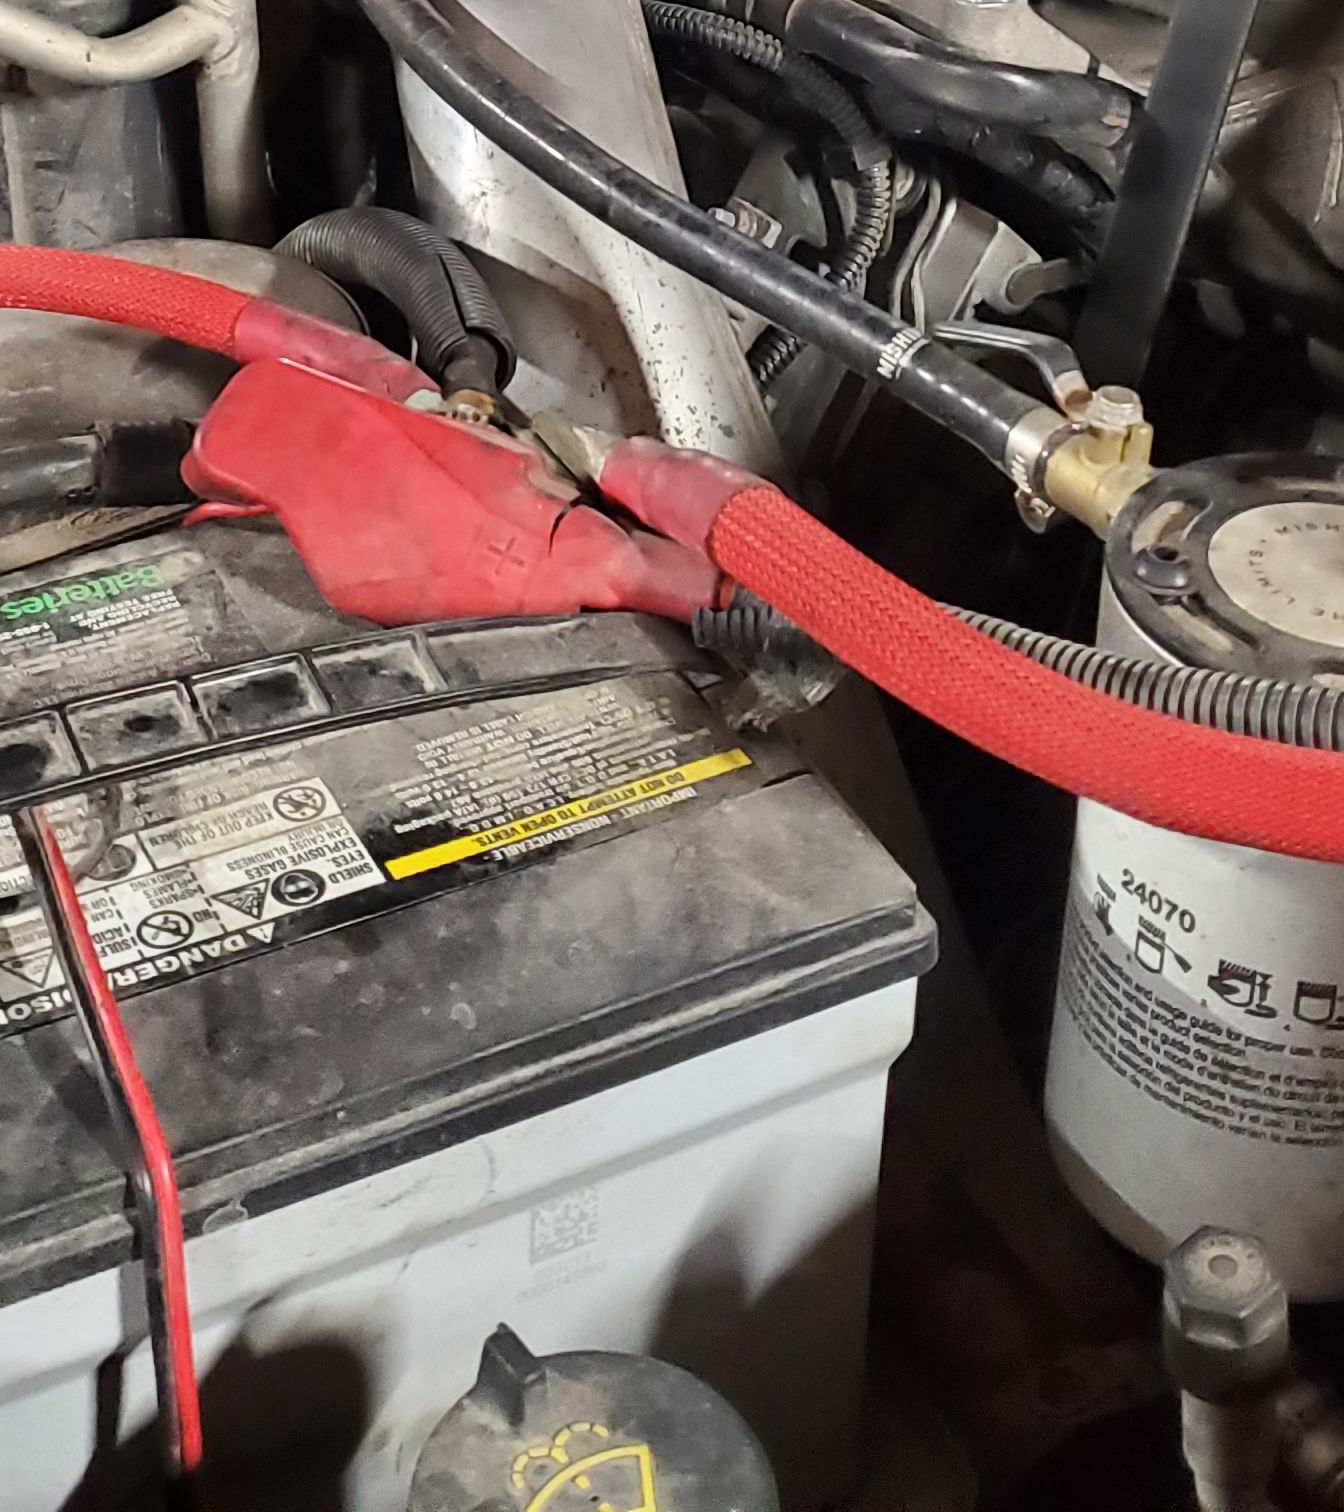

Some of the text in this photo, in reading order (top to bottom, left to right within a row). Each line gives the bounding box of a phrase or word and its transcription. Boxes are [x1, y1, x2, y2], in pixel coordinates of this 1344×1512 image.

[77, 614, 104, 627] AND
[226, 799, 267, 822] REACH
[471, 770, 684, 850] DO NOT ATTEMPT TO OPEN VENTS.
[489, 783, 697, 863] IMPORTANT NONSERVICEABLE
[147, 818, 209, 847] CHILDREN
[173, 809, 274, 850] KEEP OUT OF THE
[225, 824, 350, 873] CAN CAUSE BLINDNESS
[243, 834, 357, 881] EXPLOSIVE GASES
[325, 847, 364, 870] EYES.
[327, 860, 374, 886] SHIELD
[142, 875, 188, 899] FLAMES
[90, 896, 108, 910] OR
[1121, 868, 1198, 934] 24070
[89, 907, 114, 923] CAN
[91, 925, 123, 944] ACID
